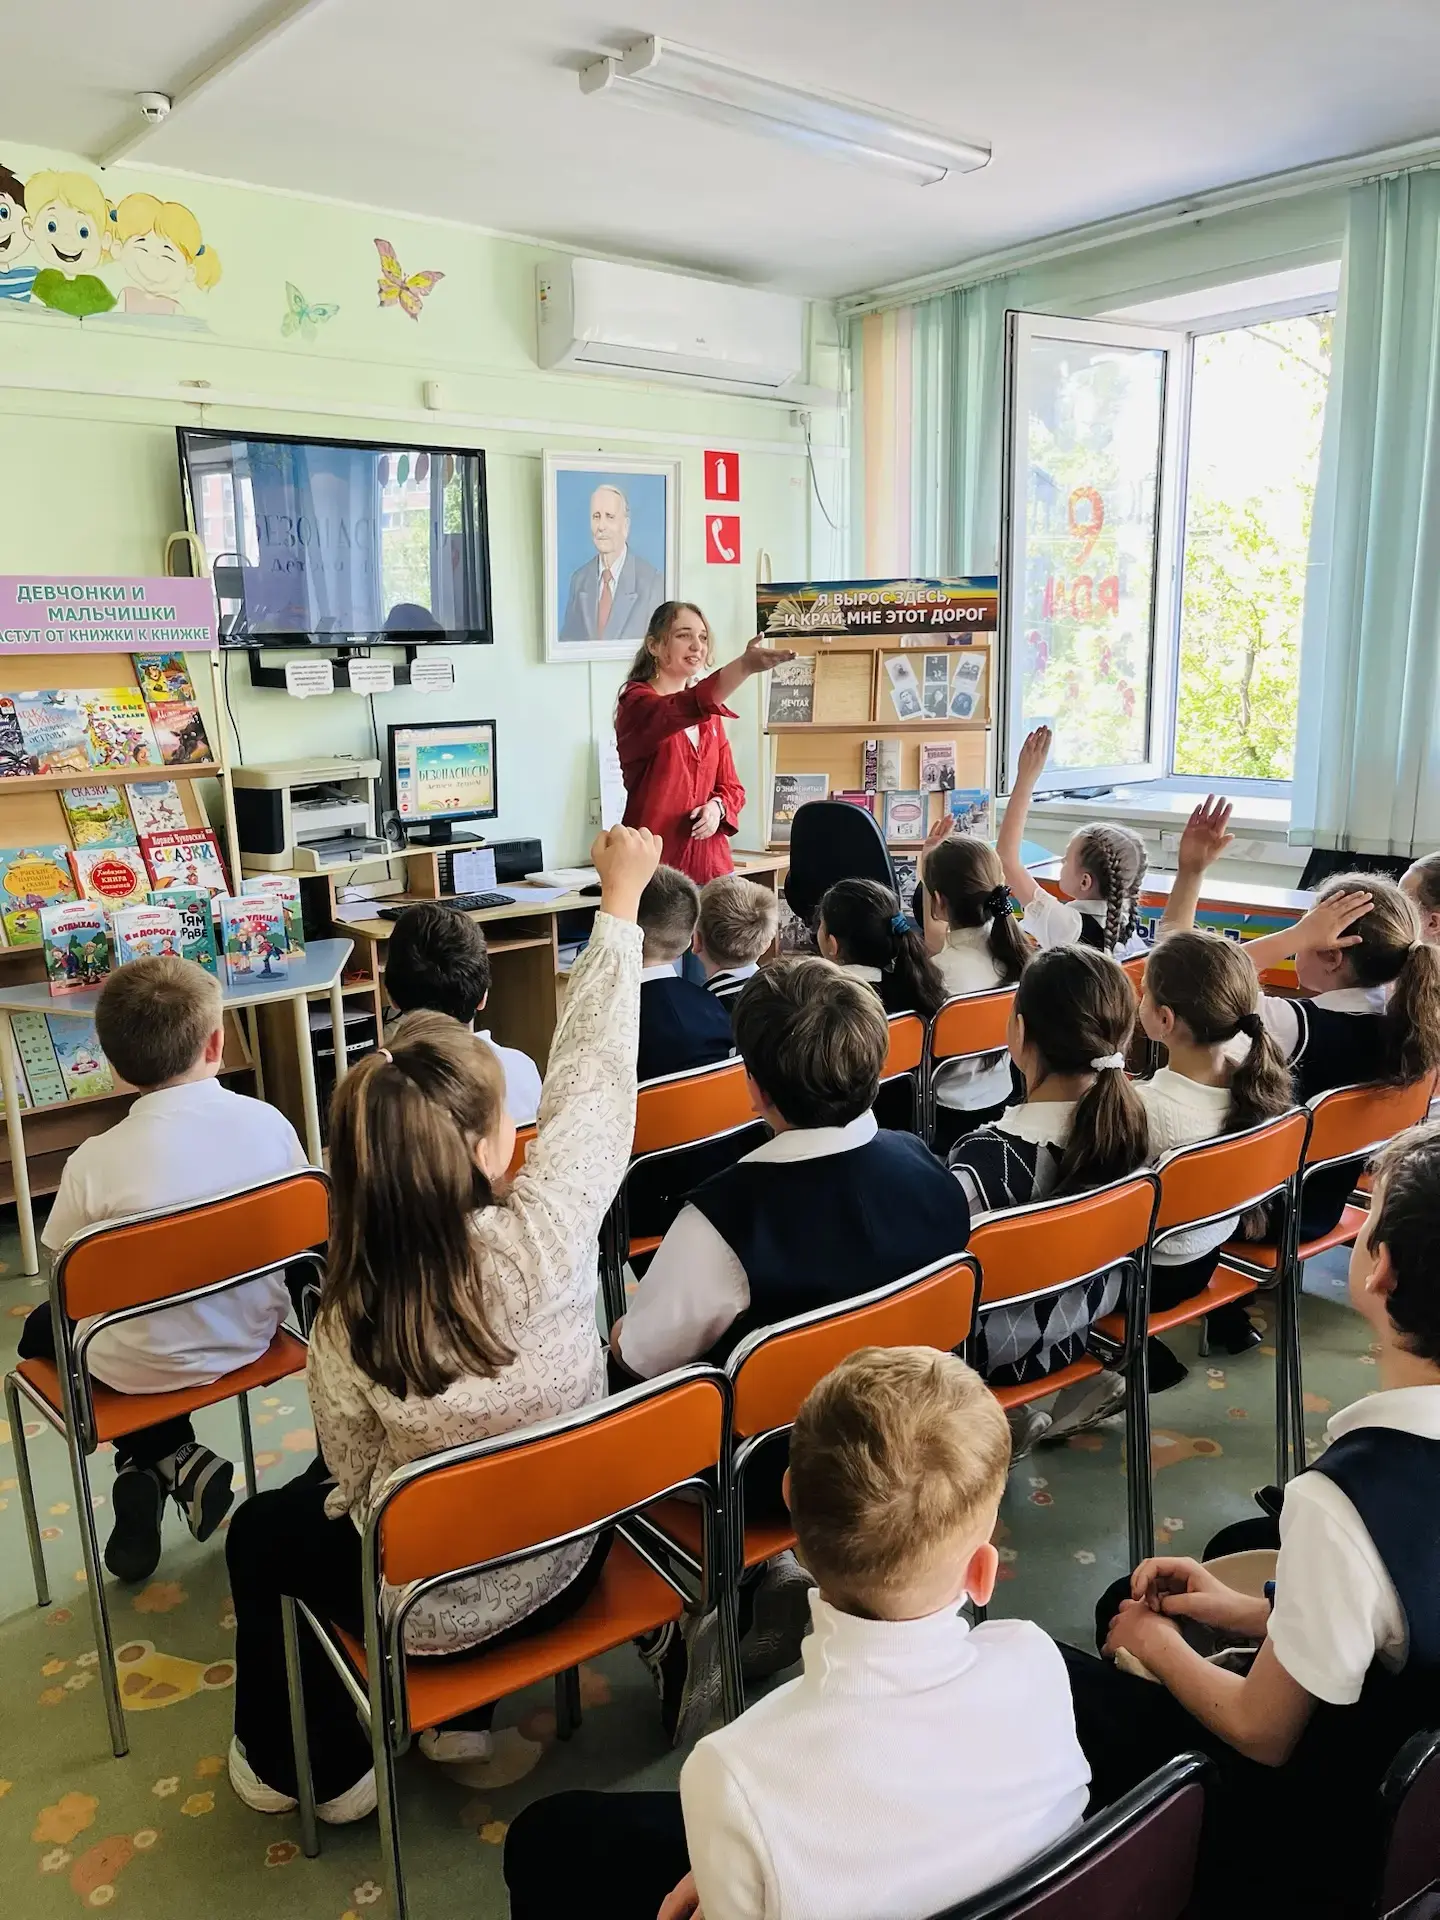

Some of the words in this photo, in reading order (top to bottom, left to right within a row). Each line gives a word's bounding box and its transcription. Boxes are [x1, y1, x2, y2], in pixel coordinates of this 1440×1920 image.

[18, 585, 125, 602] ДЕВЧОНКИ
[132, 586, 144, 600] И
[818, 593, 829, 607] Я
[834, 591, 891, 606] ВЫРОС
[895, 589, 952, 606] ЗДЕСЬ,
[48, 606, 176, 622] МАЛЬЧИШКИ
[784, 613, 796, 626] И
[800, 608, 843, 626] КРАЙ
[847, 610, 882, 625] МНЕ
[885, 609, 927, 624] ЭТОТ
[930, 607, 988, 624] ДОРОГ
[46, 629, 65, 642] ОТ
[70, 628, 134, 641] КНИЖКИ
[139, 628, 147, 641] К
[152, 628, 210, 640] КНИЖКЕ
[781, 699, 809, 707] МЕЧТАХ
[71, 785, 109, 797] СКАЗКИ
[154, 843, 215, 863] СКАЗКИ
[58, 920, 101, 933] ОТДЫХАЮ
[179, 912, 206, 927] ТЯМ
[124, 933, 132, 942] Я
[140, 929, 177, 938] ДОРОГА
[180, 927, 208, 939] РАВЕ
[176, 1445, 193, 1465] NIKE
